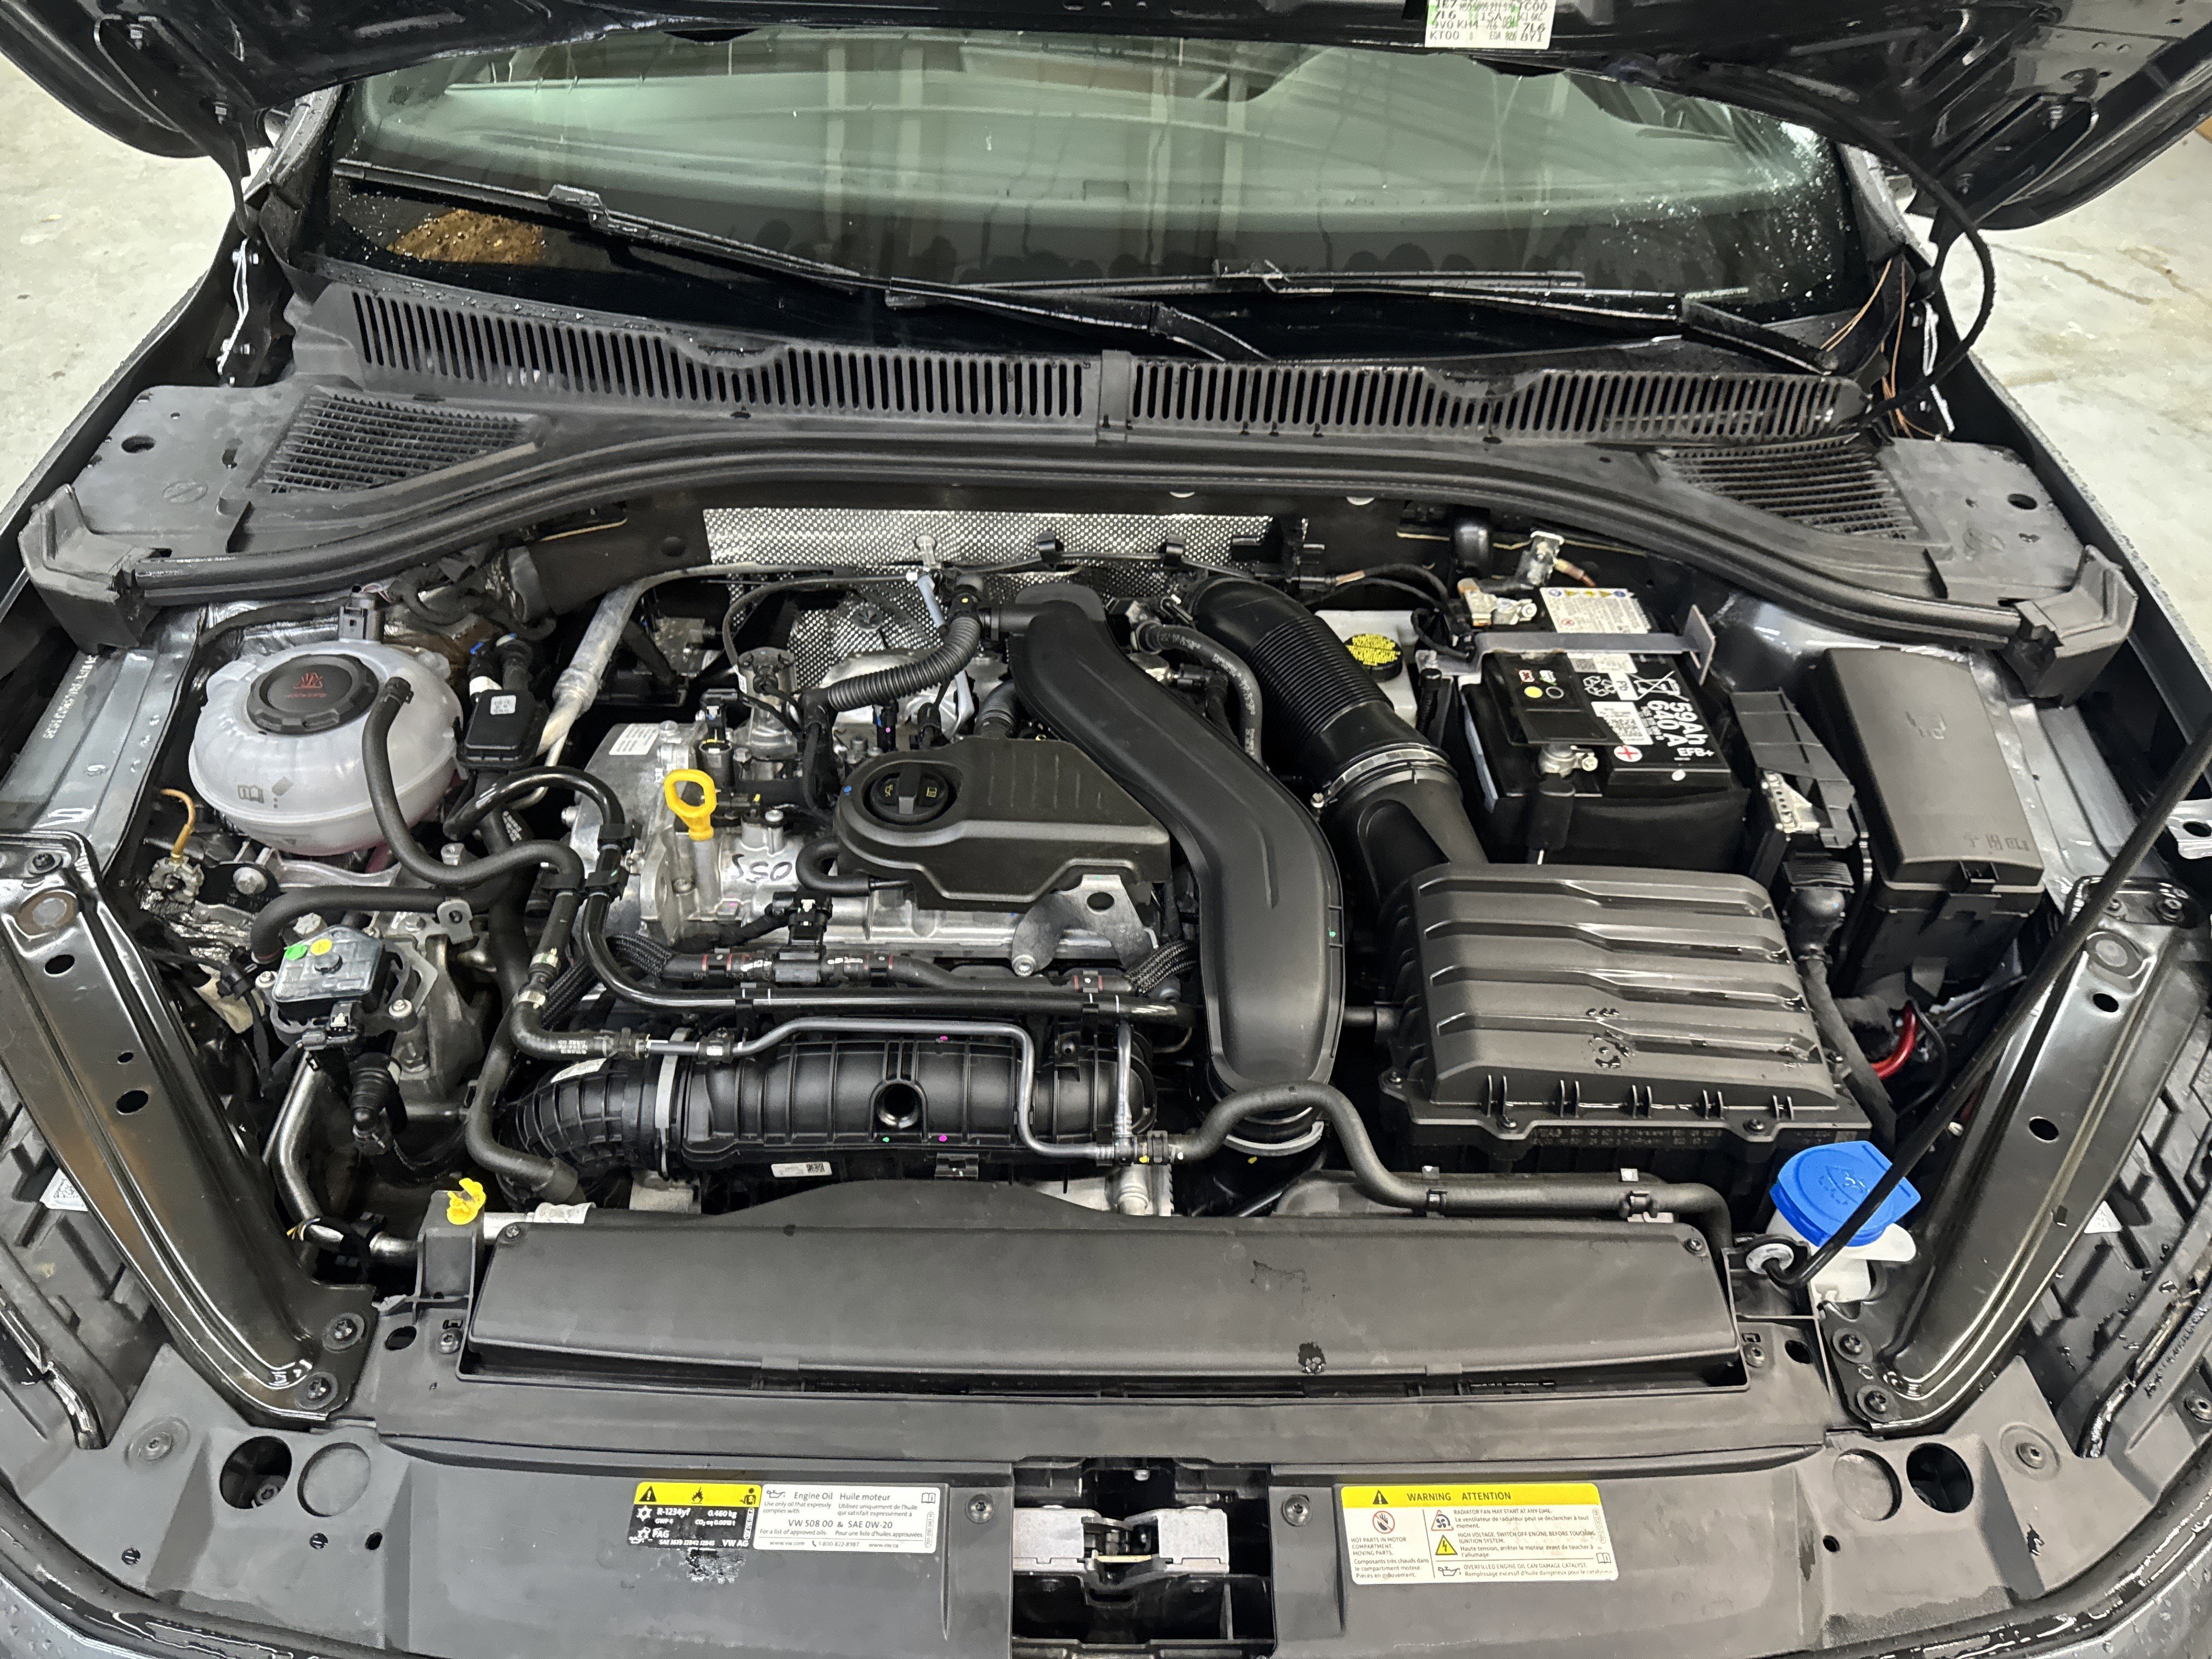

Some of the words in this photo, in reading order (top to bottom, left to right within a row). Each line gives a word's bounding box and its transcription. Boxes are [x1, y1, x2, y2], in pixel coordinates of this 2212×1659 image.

[1616, 681, 1628, 691] Pb
[1647, 700, 1679, 730] 640
[1663, 733, 1688, 747] A
[1669, 702, 1708, 744] 59Ah
[794, 1492, 820, 1501] Engine
[1407, 1492, 1452, 1502] WARNING
[1462, 1492, 1511, 1501] ATTENTION
[657, 1508, 691, 1518] R-1234yf
[652, 1528, 669, 1538] PAG
